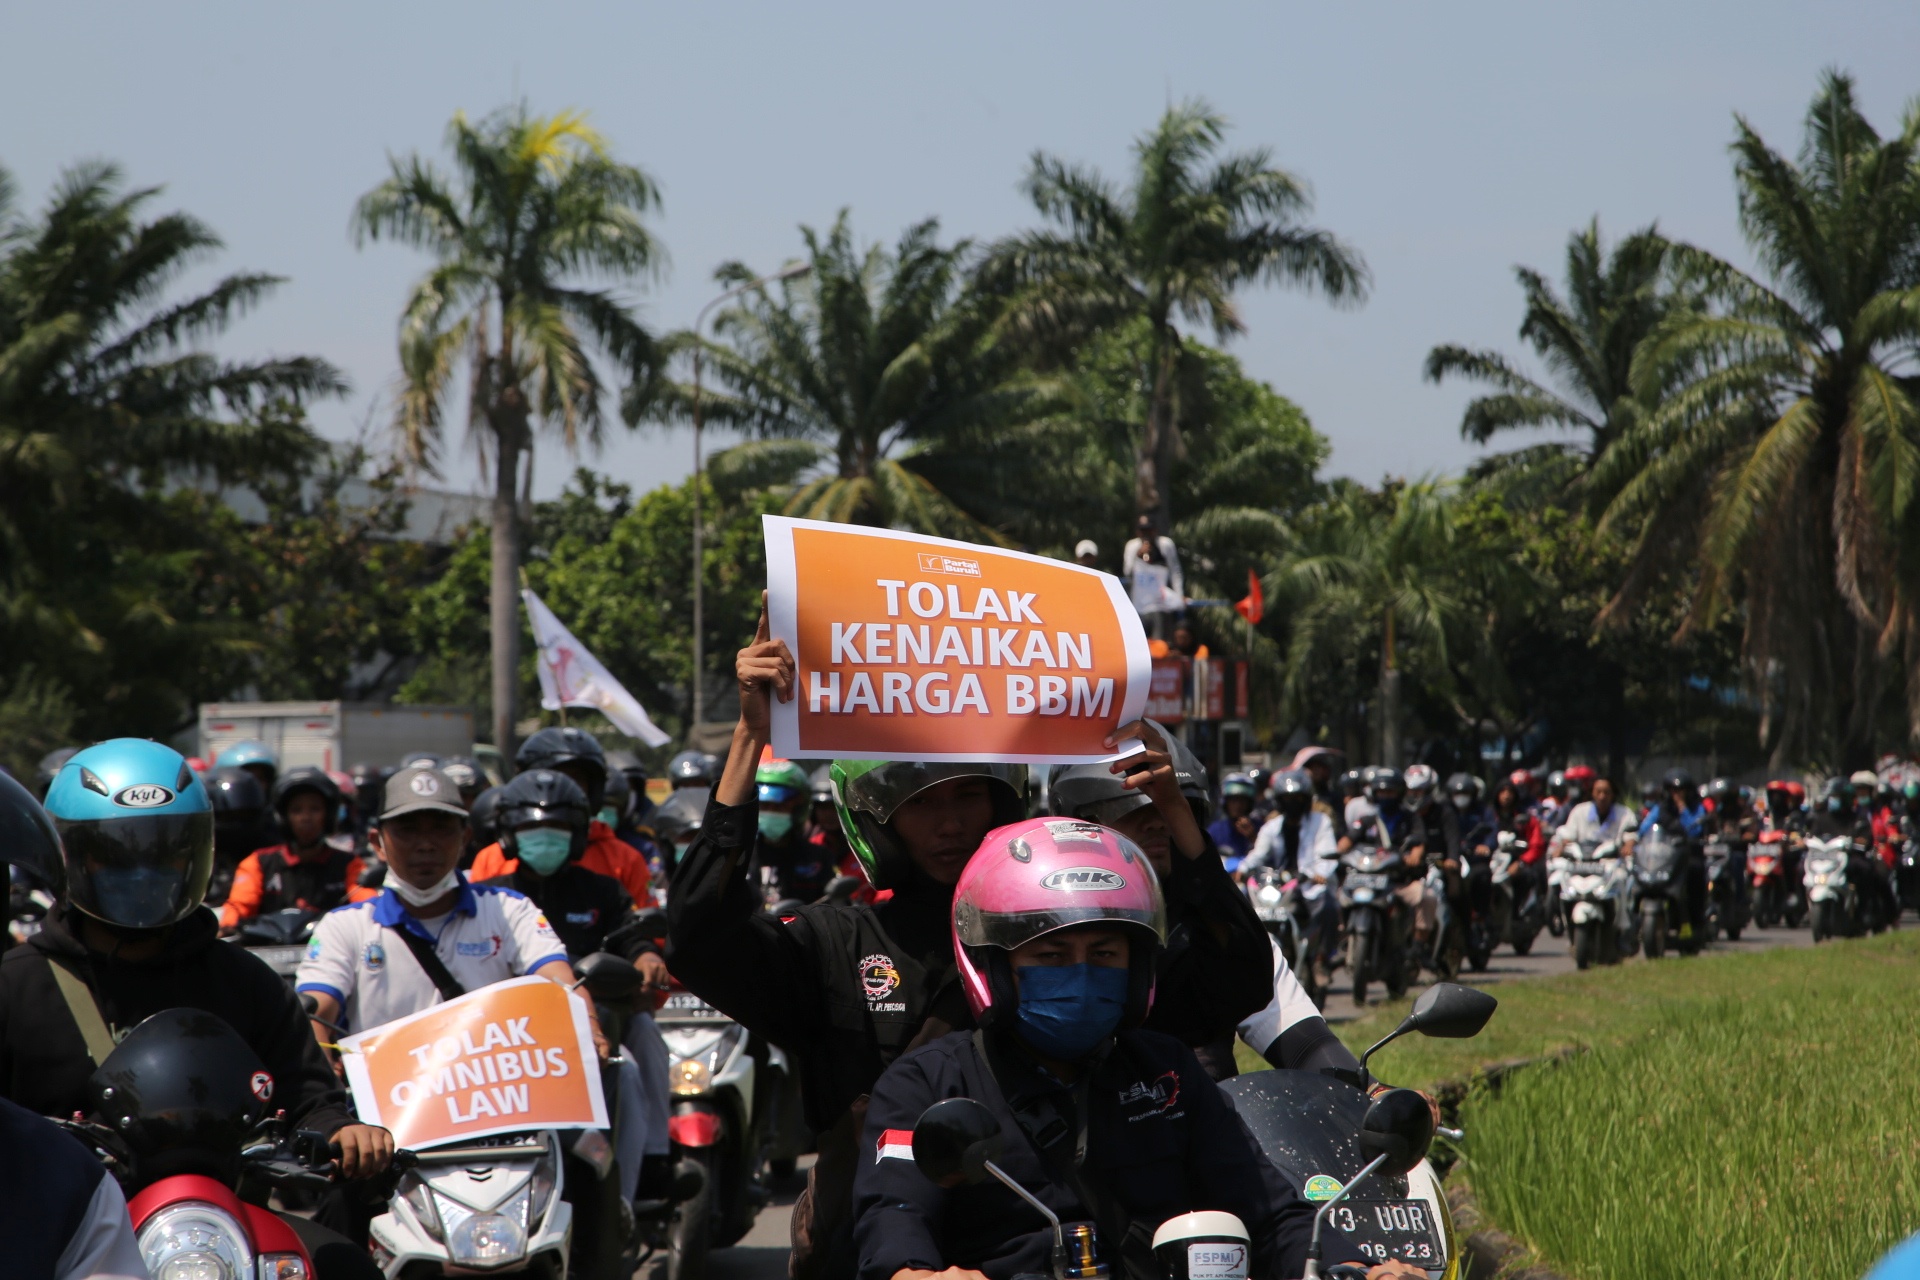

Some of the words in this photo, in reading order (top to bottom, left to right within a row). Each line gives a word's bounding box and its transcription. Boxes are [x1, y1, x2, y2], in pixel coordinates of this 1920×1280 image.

[943, 558, 978, 569] Partai
[945, 565, 979, 575] Buruh
[877, 579, 1044, 625] TOLAK
[831, 622, 1093, 670] KENAIKAN
[809, 672, 990, 715] HARGA
[1006, 674, 1114, 719] BBM
[1052, 872, 1116, 886] INK
[408, 1016, 537, 1071] TOLAK
[389, 1047, 569, 1107] OMNIBUS
[445, 1083, 530, 1125] LAW
[1194, 1252, 1234, 1263] FSPMI
